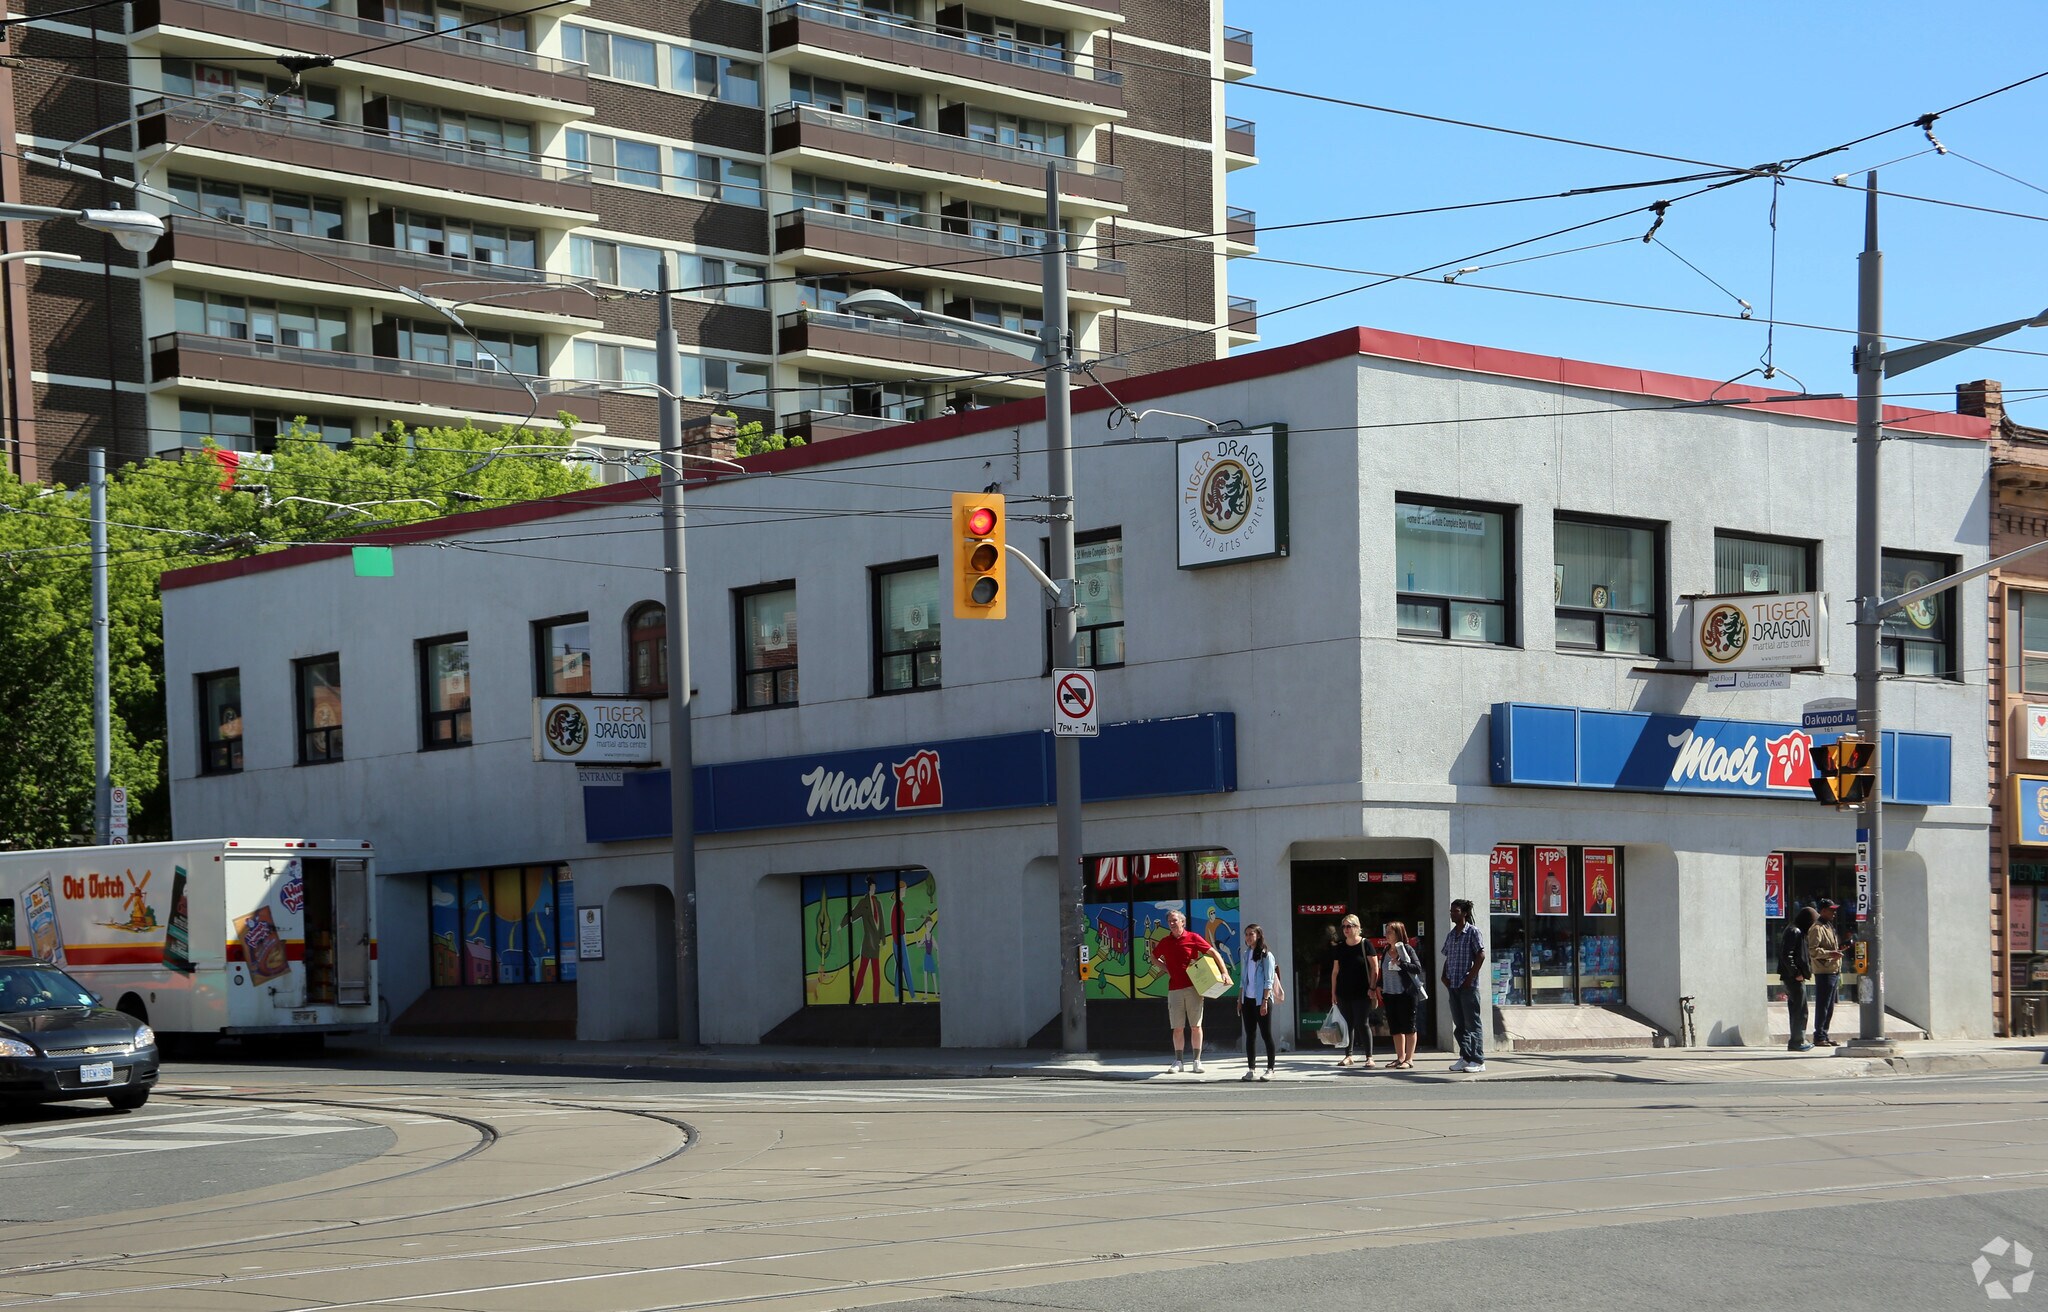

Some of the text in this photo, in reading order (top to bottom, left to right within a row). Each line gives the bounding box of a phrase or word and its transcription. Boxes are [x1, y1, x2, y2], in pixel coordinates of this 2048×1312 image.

[1185, 439, 1268, 504] TIGER DRAGON
[1189, 496, 1265, 553] martial arts centre
[1751, 600, 1810, 622] TIGER
[1751, 619, 1811, 641] DRAGON
[1752, 639, 1810, 651] martial arts centre
[1720, 674, 1734, 682] Floor
[1739, 680, 1769, 689] Oakwood
[593, 705, 646, 722] TIGER
[1804, 712, 1855, 726] Oakwood Av
[594, 722, 647, 740] DRAGON
[1057, 722, 1073, 732] 7PM
[1081, 722, 1096, 733] 7AM
[596, 740, 647, 749] martial arts centre
[1667, 728, 1762, 786] Mac's
[579, 771, 622, 782] ENTRANCE
[801, 762, 890, 817] Mac's
[1490, 850, 1514, 865] 3/$6
[63, 874, 85, 900] Old
[88, 873, 125, 899] Dutch
[1858, 874, 1867, 911] STOP
